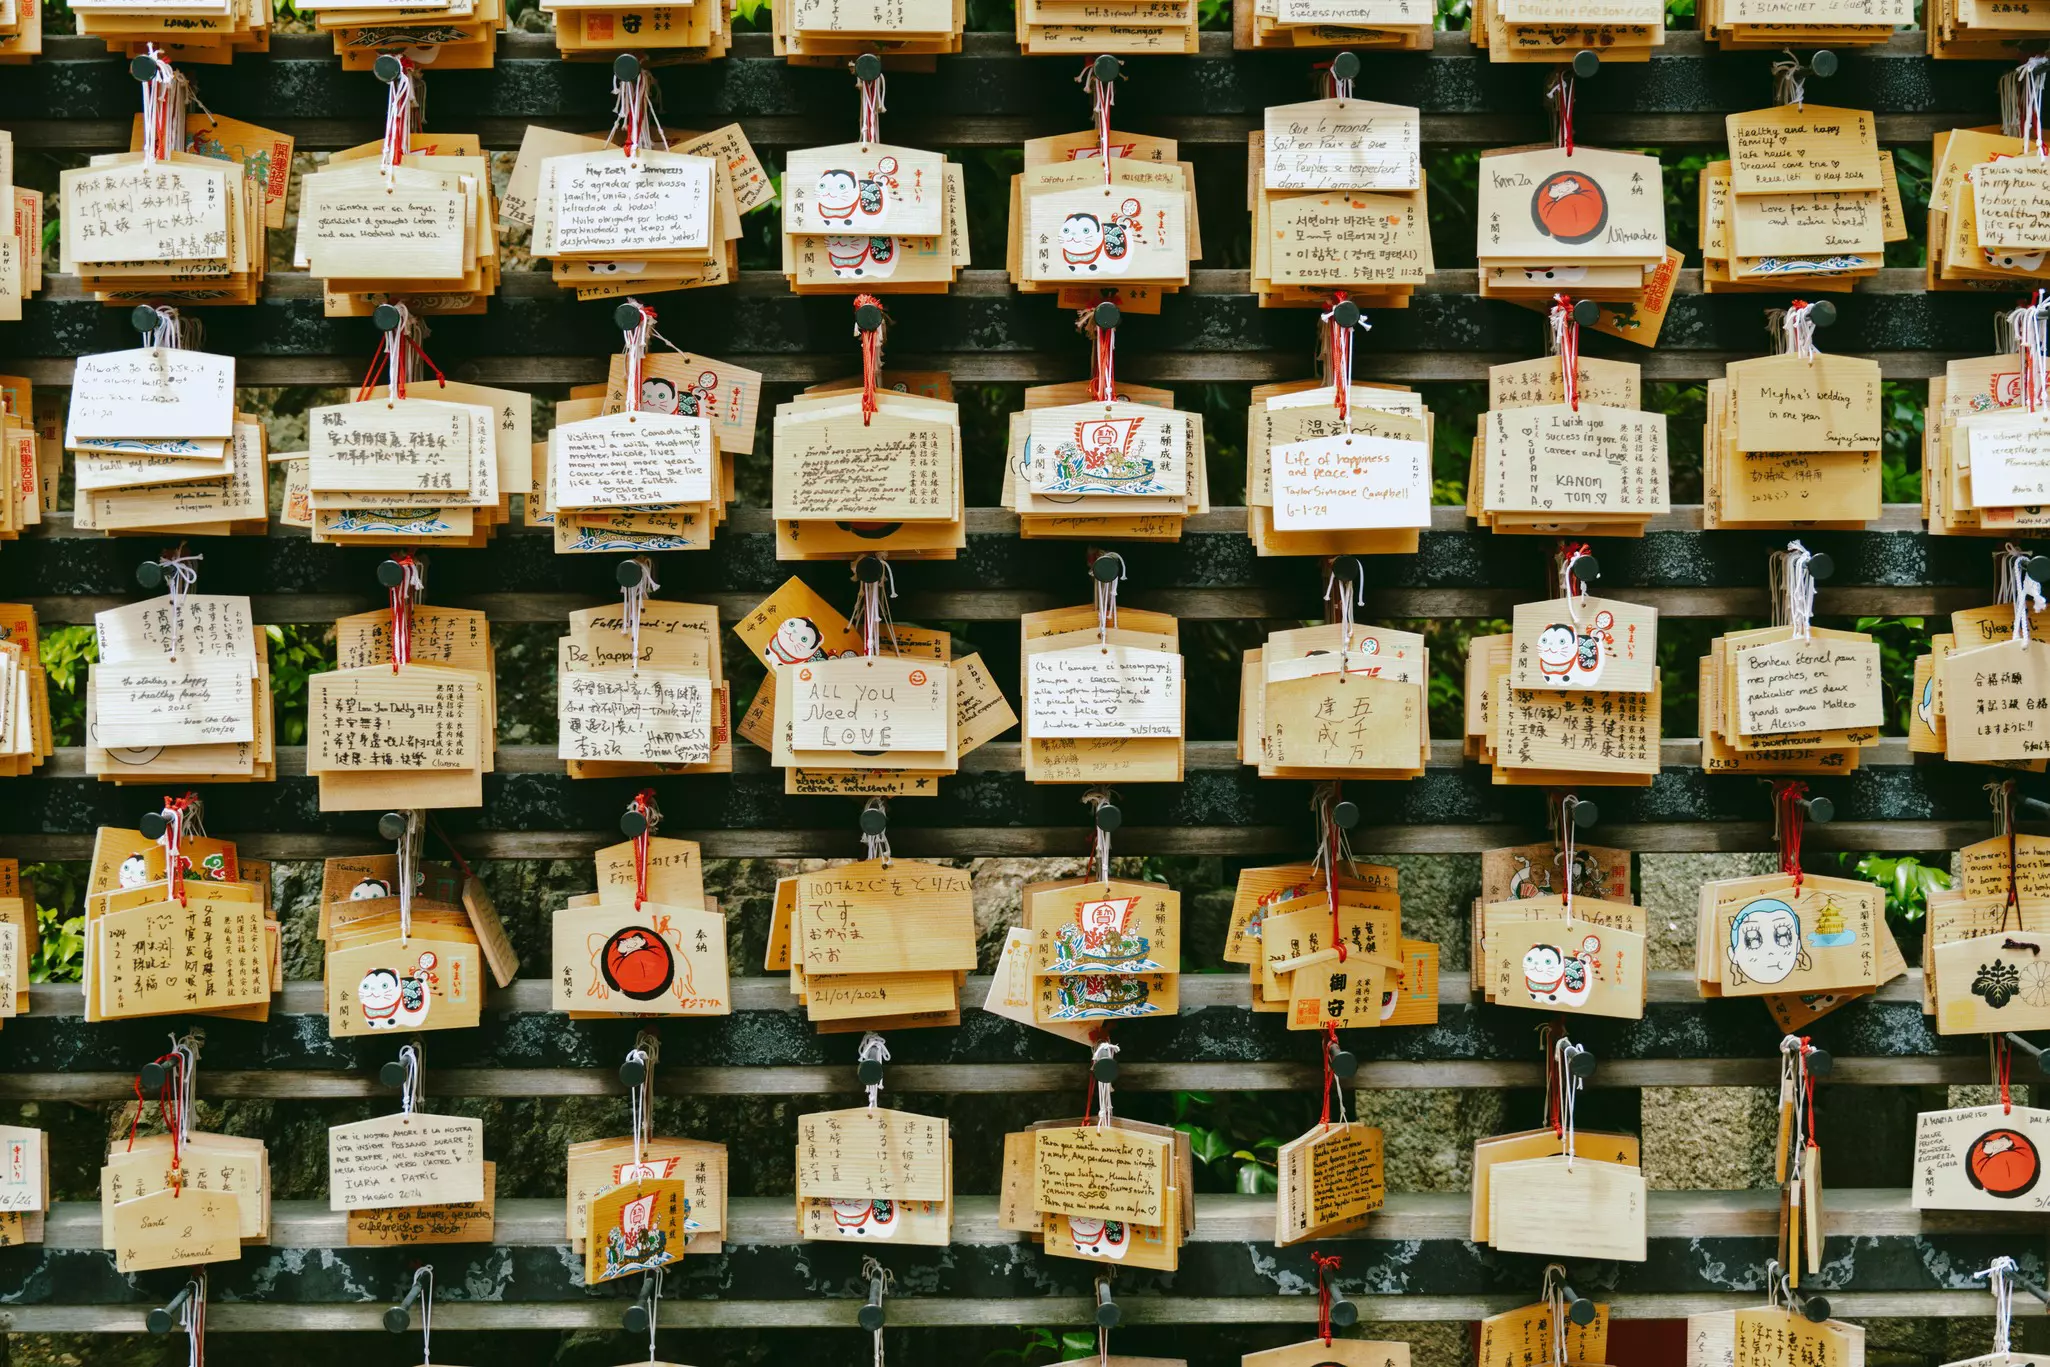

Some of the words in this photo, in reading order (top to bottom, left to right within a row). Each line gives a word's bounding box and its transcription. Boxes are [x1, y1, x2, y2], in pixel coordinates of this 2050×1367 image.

[1784, 125, 1806, 134] and
[1813, 124, 1840, 136] happy
[794, 188, 804, 226] 金閣寺
[1039, 233, 1049, 273] 金閣寺
[1817, 390, 1851, 409] wedding
[1562, 415, 1583, 427] wish
[1769, 410, 1778, 419] in
[1783, 412, 1797, 420] one
[567, 432, 606, 447] Visiting
[611, 430, 635, 439] from
[641, 428, 681, 437] Canada
[624, 438, 649, 448] wish
[1546, 433, 1580, 441] success
[1584, 432, 1594, 442] in
[650, 448, 675, 456] lives
[1285, 451, 1310, 466] Life
[1318, 452, 1331, 465] of
[1337, 453, 1390, 468] happiness
[1545, 446, 1577, 455] career
[1582, 448, 1602, 458] and
[664, 457, 694, 468] years
[1288, 468, 1306, 476] and
[1556, 475, 1602, 488] KANOM
[568, 645, 590, 662] Be
[1518, 642, 1528, 681] 金閣寺
[1748, 656, 1791, 669] Bonheur
[1796, 650, 1831, 664] éternel
[810, 683, 842, 699] ALL
[1799, 687, 1817, 695] mes
[1822, 684, 1848, 693] deux
[803, 699, 858, 722] Need
[874, 710, 889, 722] is
[1749, 706, 1778, 721] grands
[1347, 697, 1373, 764] 五千万
[1750, 721, 1763, 731] et
[822, 726, 892, 748] LOVE
[696, 928, 708, 953] 奉納
[1039, 929, 1048, 967] 金閣寺
[1327, 973, 1347, 1017] 御守
[340, 990, 350, 1030] 金閣寺
